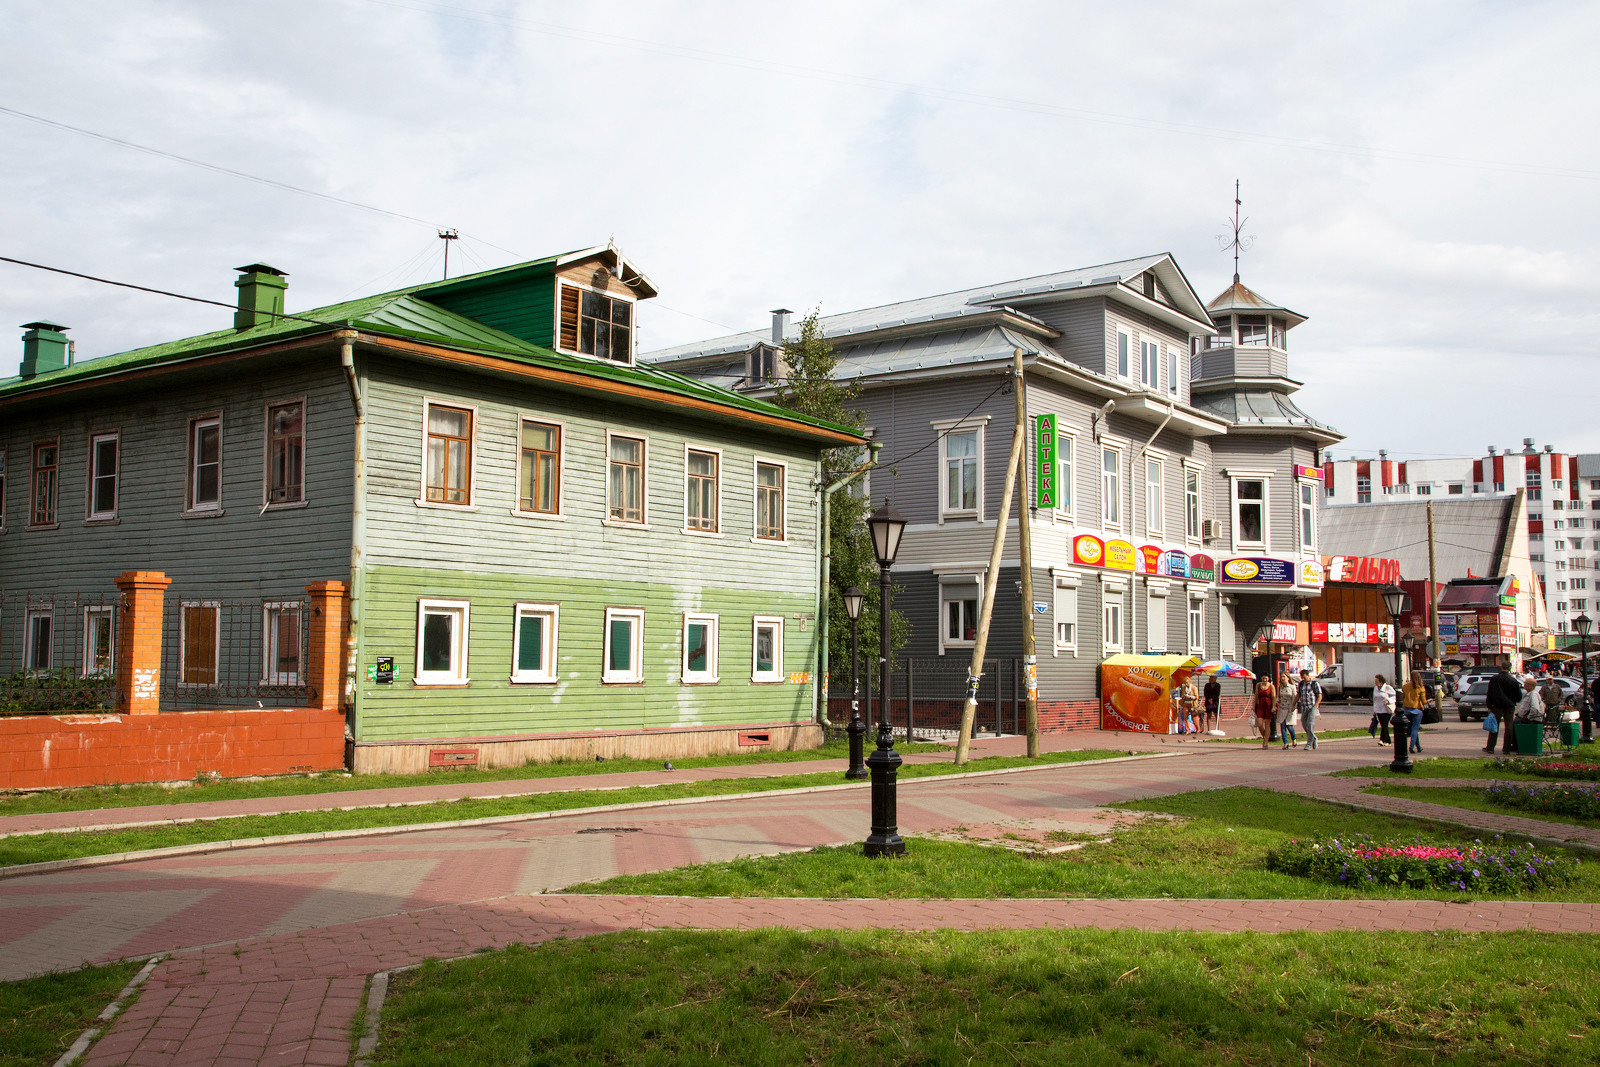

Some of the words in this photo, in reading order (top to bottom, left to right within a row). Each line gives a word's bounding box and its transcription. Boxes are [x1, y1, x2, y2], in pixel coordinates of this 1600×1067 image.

[1041, 418, 1052, 504] АПТЕКА
[1109, 545, 1132, 554] МЕБЕЛЬНЫЙ
[1114, 553, 1127, 561] САЛОН
[1128, 666, 1166, 681] ХОТ-ДОГ
[1104, 702, 1149, 731] МОРОЖЕНОЕ
